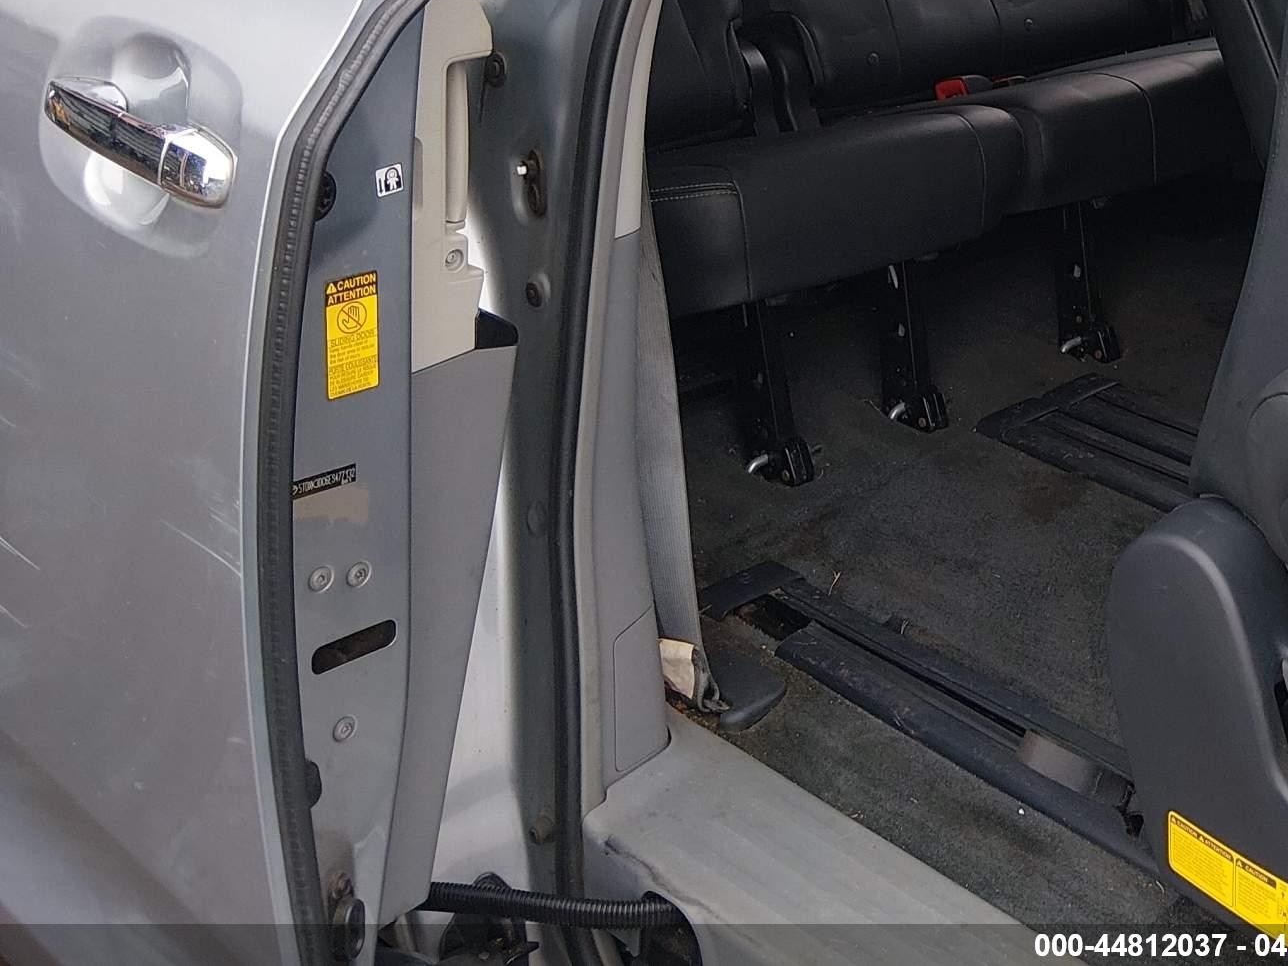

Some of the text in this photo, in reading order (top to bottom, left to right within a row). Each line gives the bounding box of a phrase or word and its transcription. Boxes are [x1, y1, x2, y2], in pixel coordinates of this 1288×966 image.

[337, 272, 377, 291] CAUTION
[327, 284, 377, 305] ATTENTION
[330, 333, 355, 348] SLIDING
[1176, 820, 1232, 860] CAUTION ATTENTION
[1245, 864, 1268, 883] CAUTION
